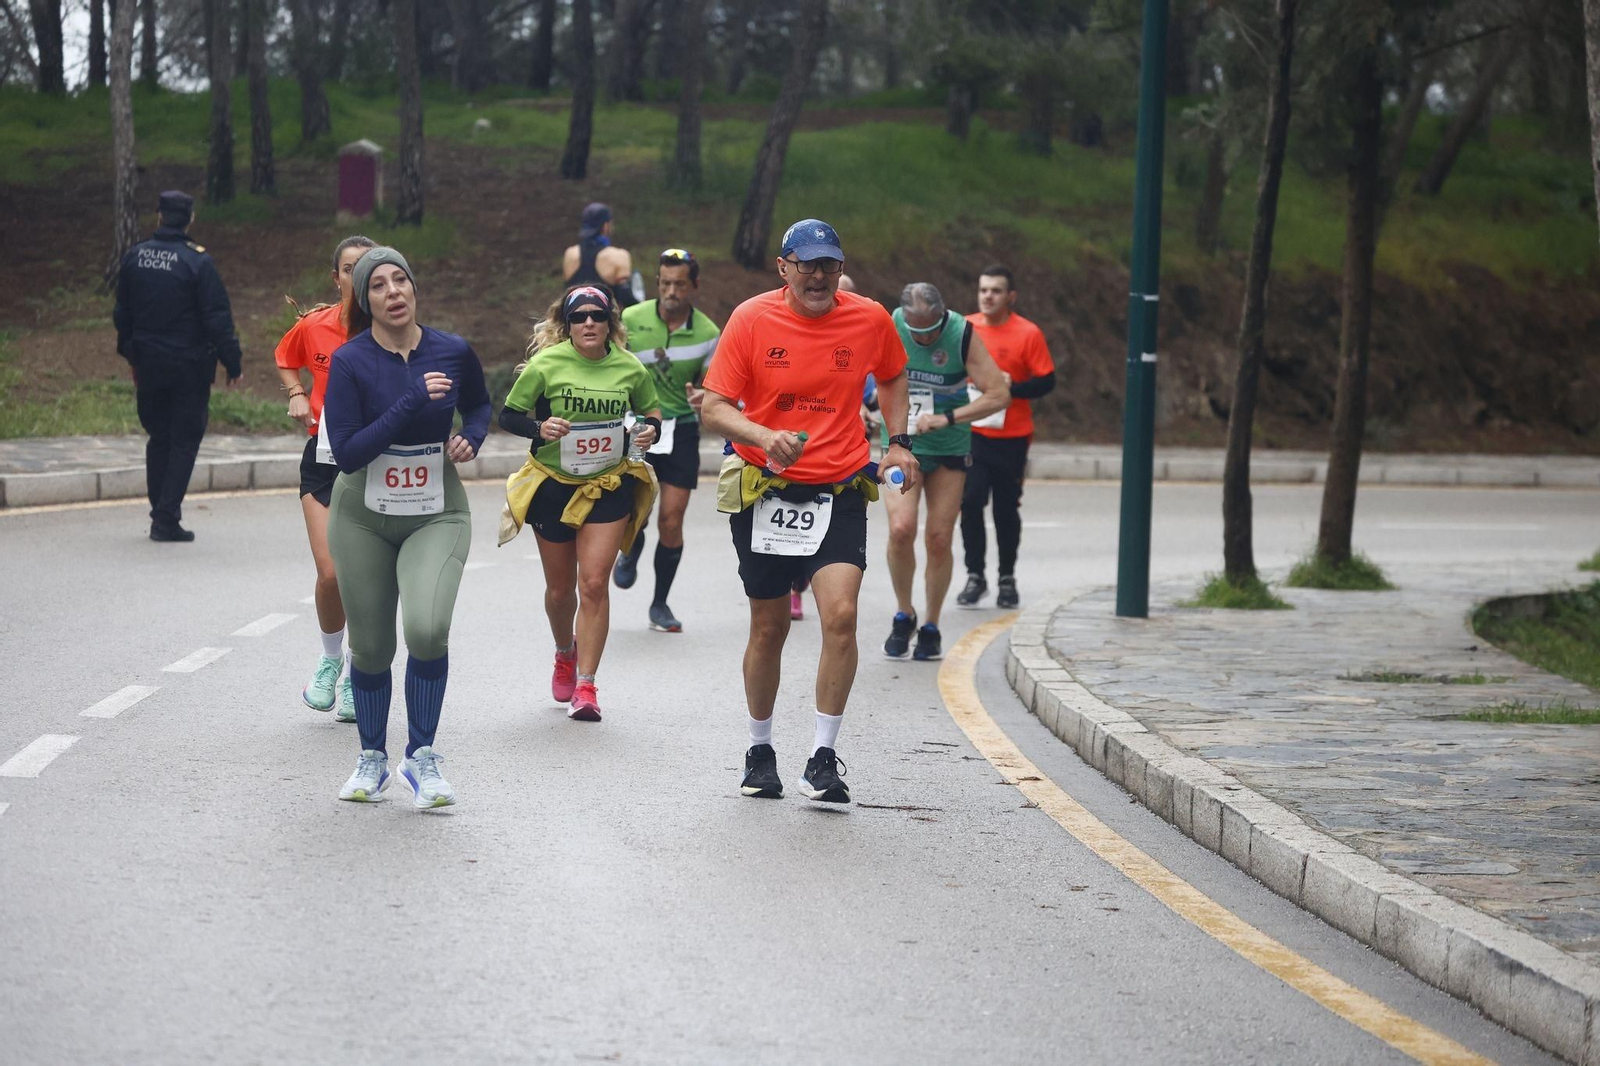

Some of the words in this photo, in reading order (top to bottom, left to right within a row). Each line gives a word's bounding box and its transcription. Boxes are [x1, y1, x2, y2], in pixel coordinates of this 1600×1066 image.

[138, 249, 178, 262] POLICIA
[138, 258, 172, 271] LOCAL
[561, 388, 573, 397] LA
[799, 396, 826, 404] Ciudad
[809, 405, 836, 414] Málaga
[576, 436, 612, 455] 592
[385, 466, 428, 488] 619
[770, 508, 815, 530] 429
